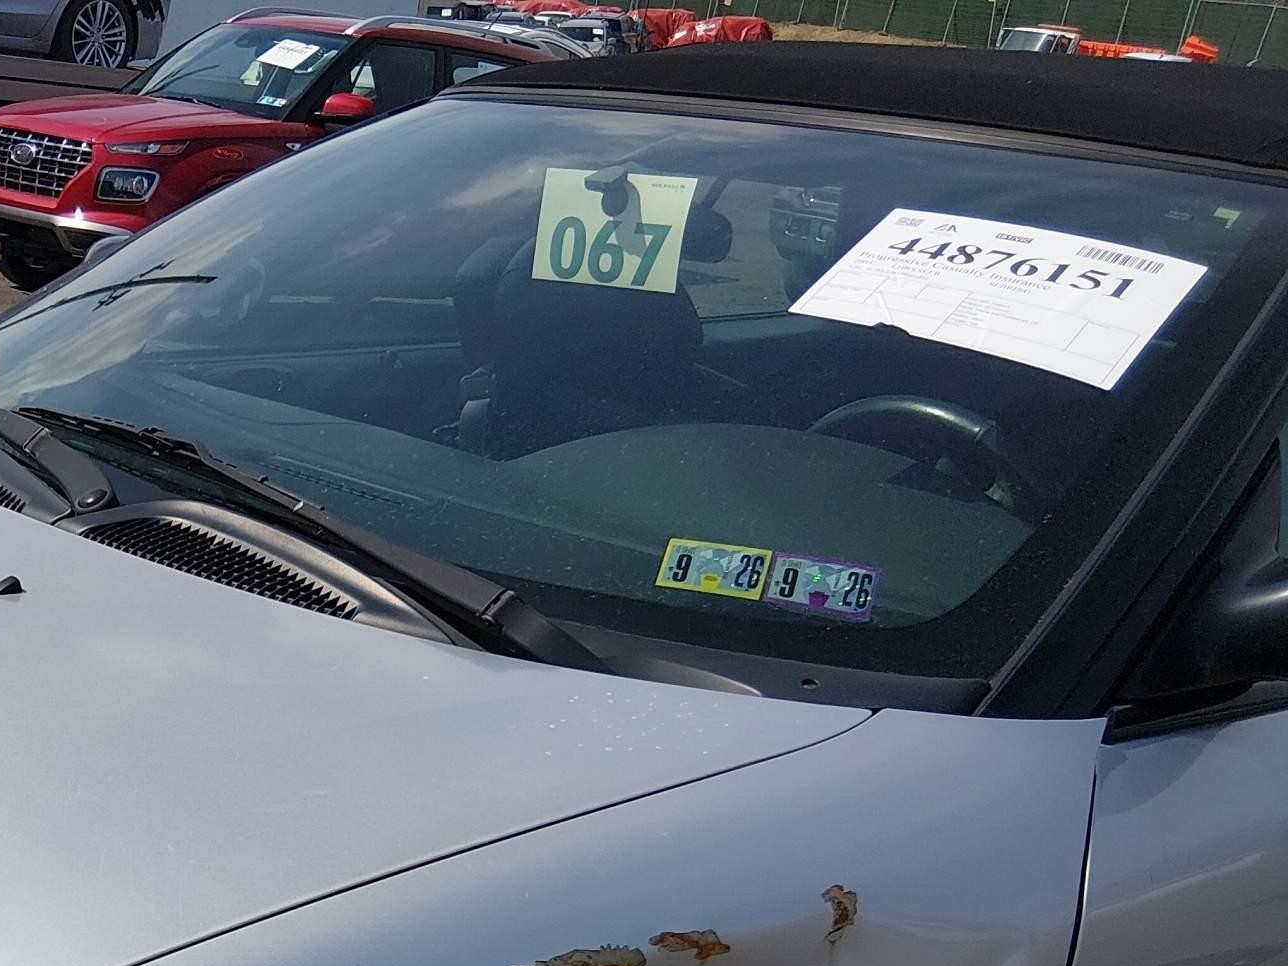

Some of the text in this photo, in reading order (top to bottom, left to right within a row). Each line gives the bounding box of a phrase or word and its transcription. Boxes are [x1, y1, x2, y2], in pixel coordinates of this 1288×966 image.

[550, 216, 672, 286] 067
[859, 251, 930, 268] Progressive
[933, 261, 986, 278] Casualty
[990, 271, 1052, 292] Insurance
[888, 237, 1135, 300] 44876151
[672, 554, 764, 589] 9 26
[779, 568, 872, 609] 9 26
